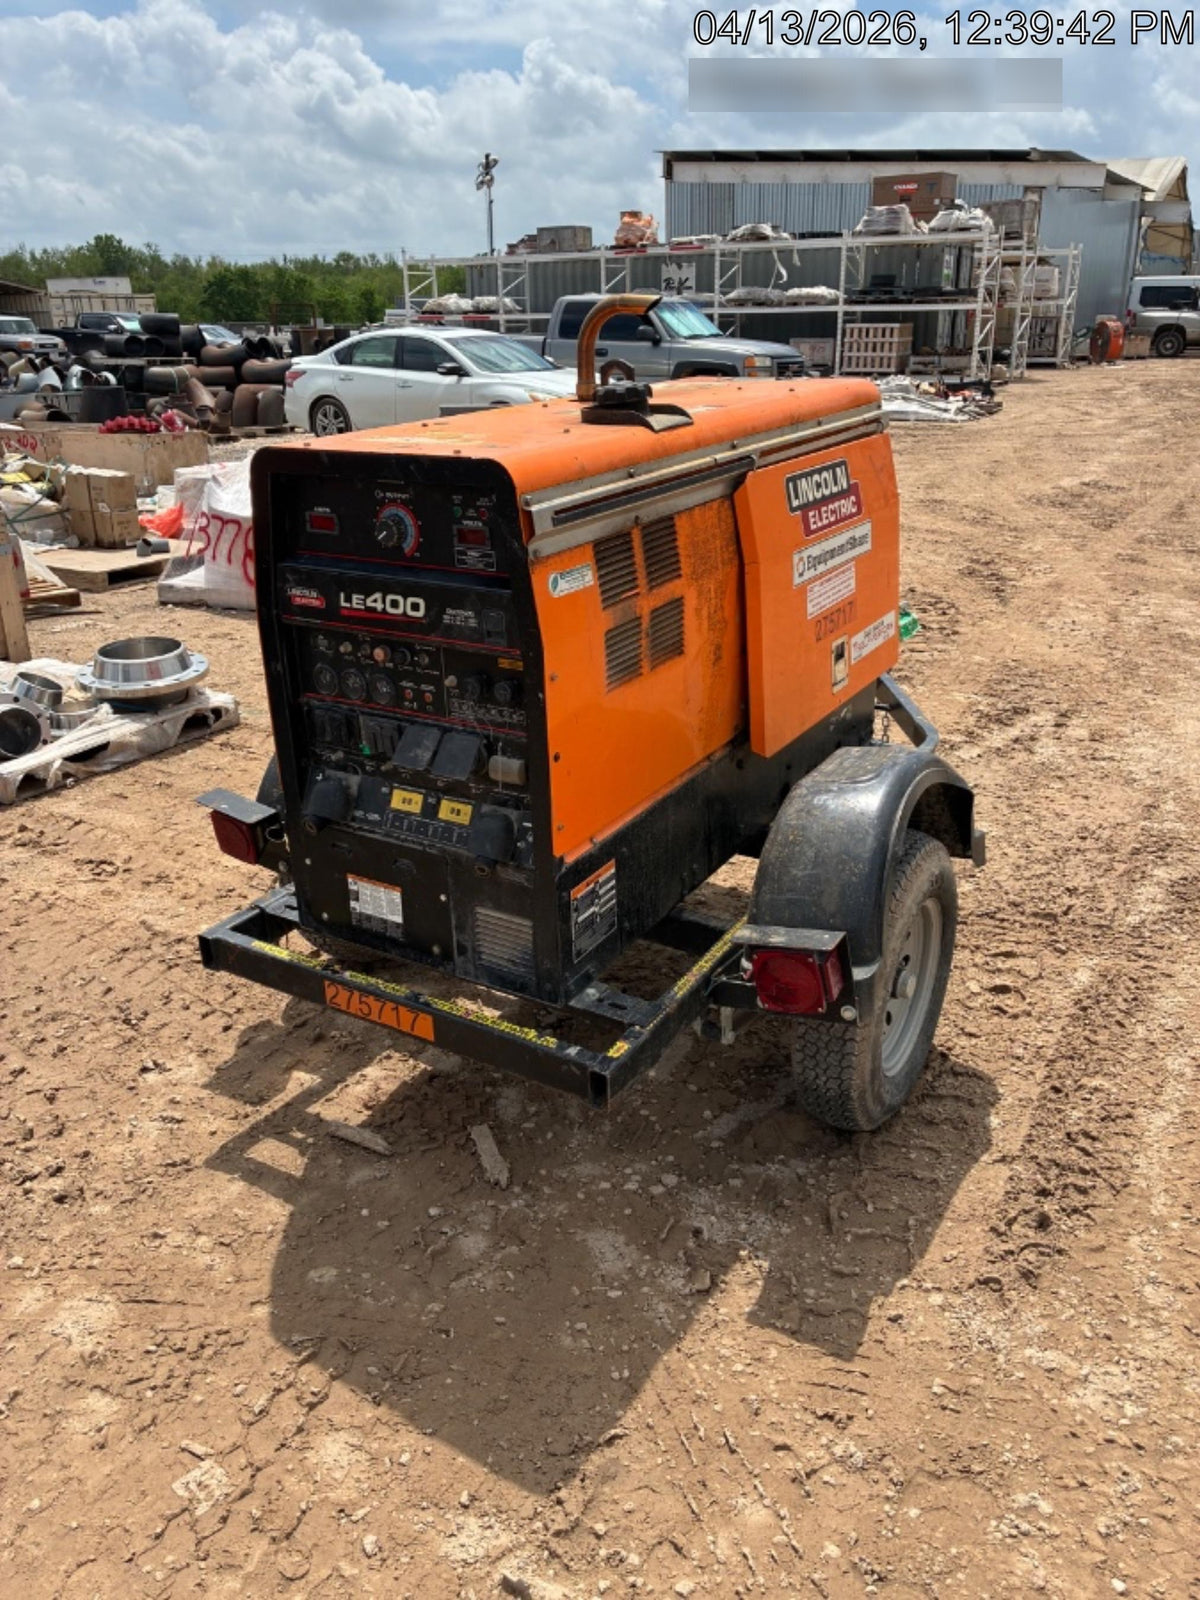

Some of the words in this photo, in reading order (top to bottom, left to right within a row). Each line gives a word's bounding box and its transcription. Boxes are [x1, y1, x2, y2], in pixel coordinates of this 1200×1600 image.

[788, 464, 849, 508] LINCOLN
[808, 495, 858, 531] ELECTRIC
[340, 591, 426, 618] LE400
[326, 982, 421, 1033] 275717
